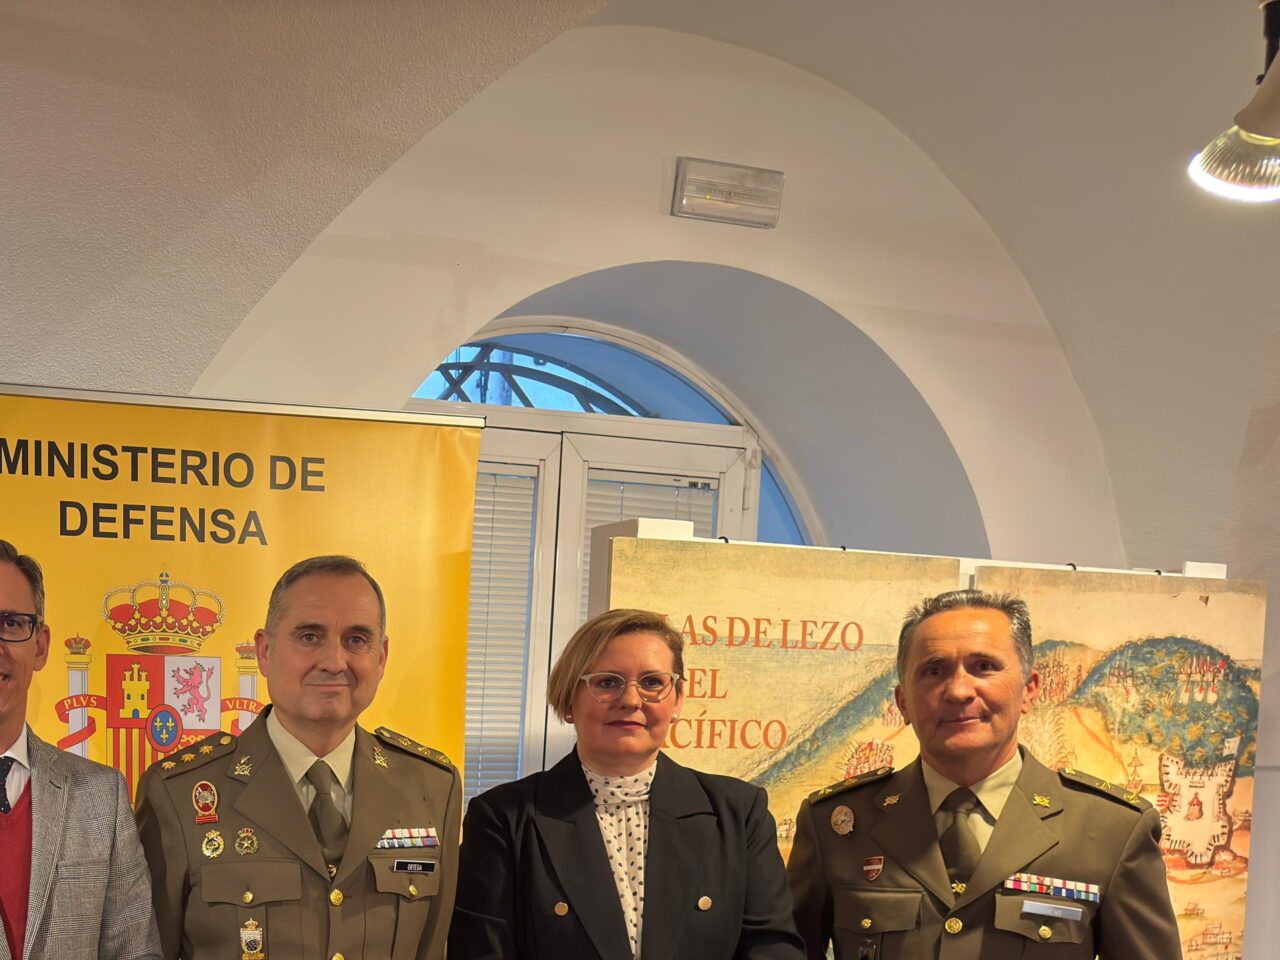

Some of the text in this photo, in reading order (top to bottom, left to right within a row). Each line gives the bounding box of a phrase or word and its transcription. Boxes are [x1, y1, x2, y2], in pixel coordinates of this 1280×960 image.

[269, 455, 326, 492] DE
[59, 500, 268, 546] DEFENSA
[662, 614, 864, 651] AS DE LEZO
[63, 696, 97, 708] PLVS
[686, 668, 728, 699] EL
[659, 710, 787, 750] CÍFICO
